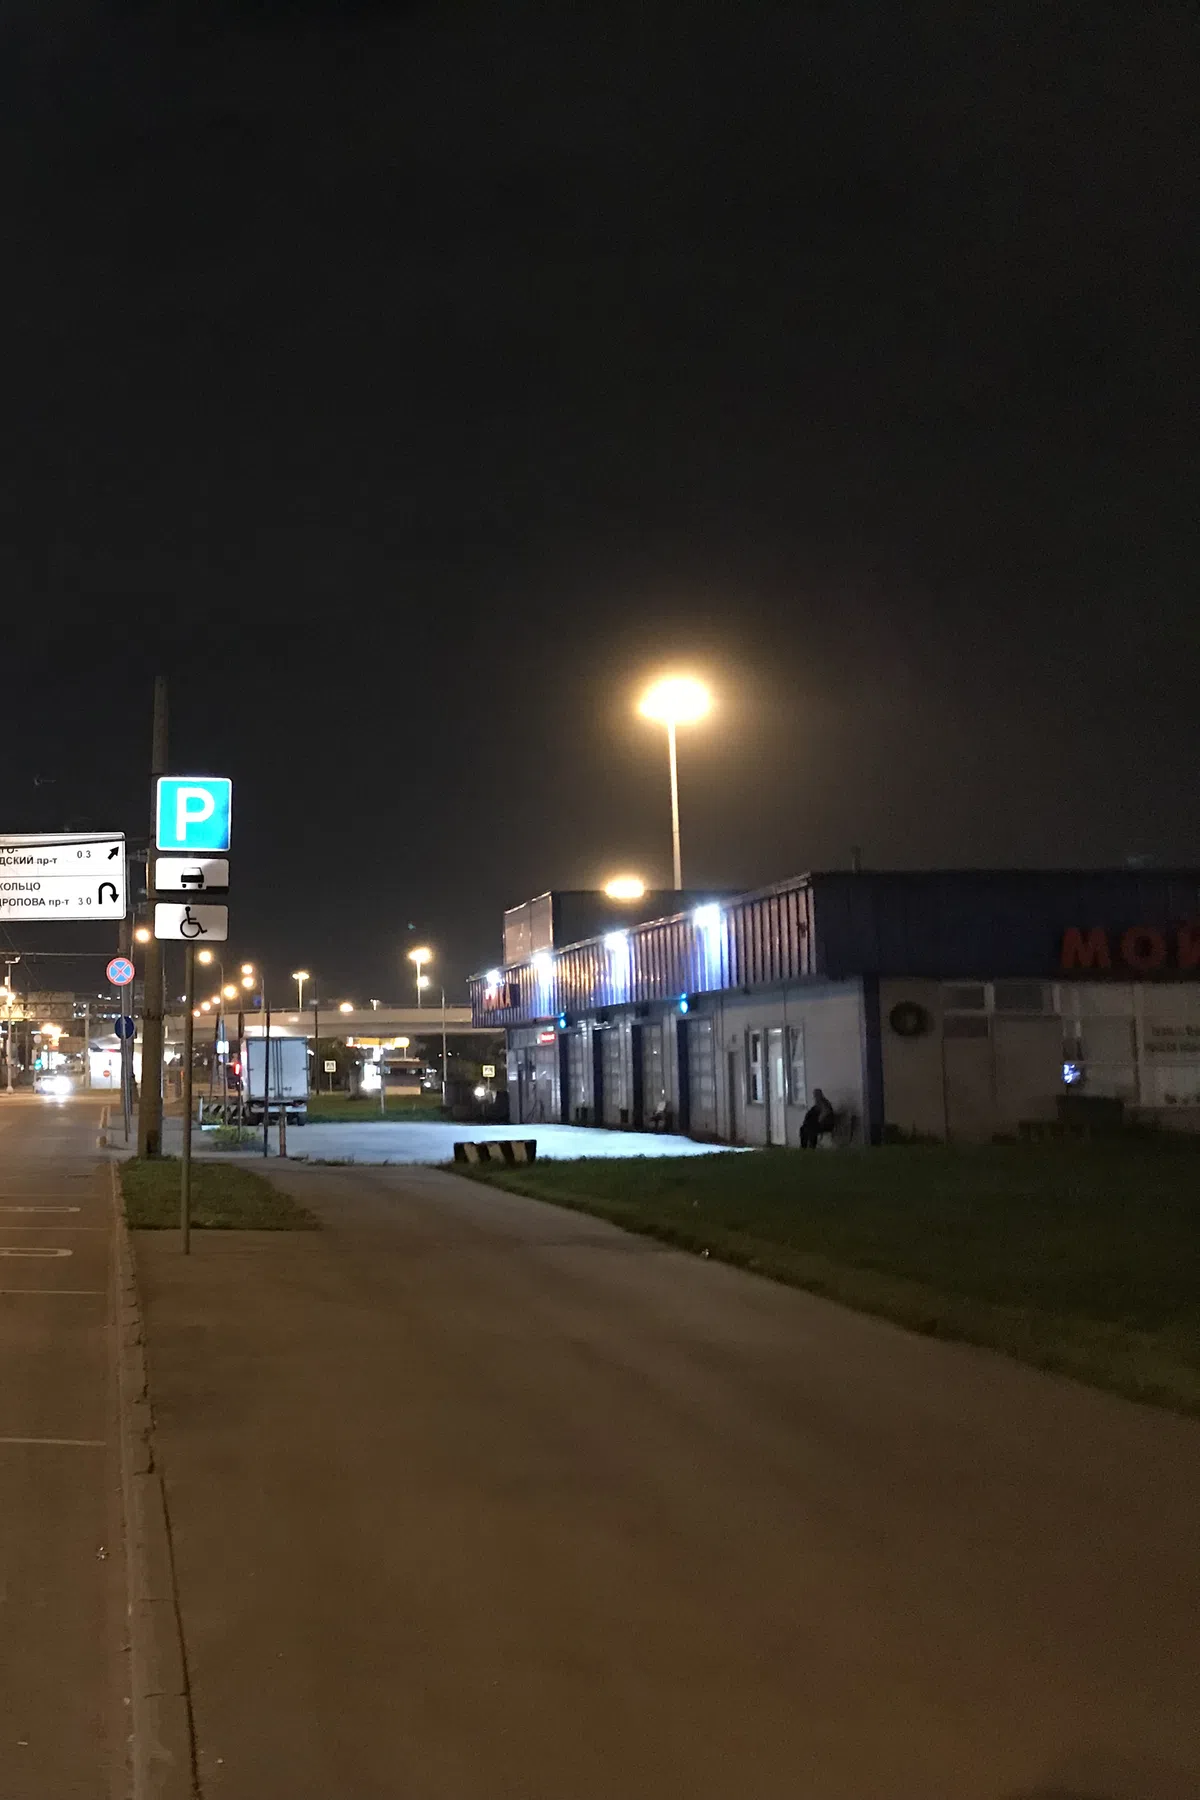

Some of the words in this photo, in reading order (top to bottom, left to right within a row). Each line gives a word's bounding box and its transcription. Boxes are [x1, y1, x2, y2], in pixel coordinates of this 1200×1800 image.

[176, 787, 215, 841] P
[36, 858, 57, 866] пр-т
[49, 899, 69, 908] пр-т
